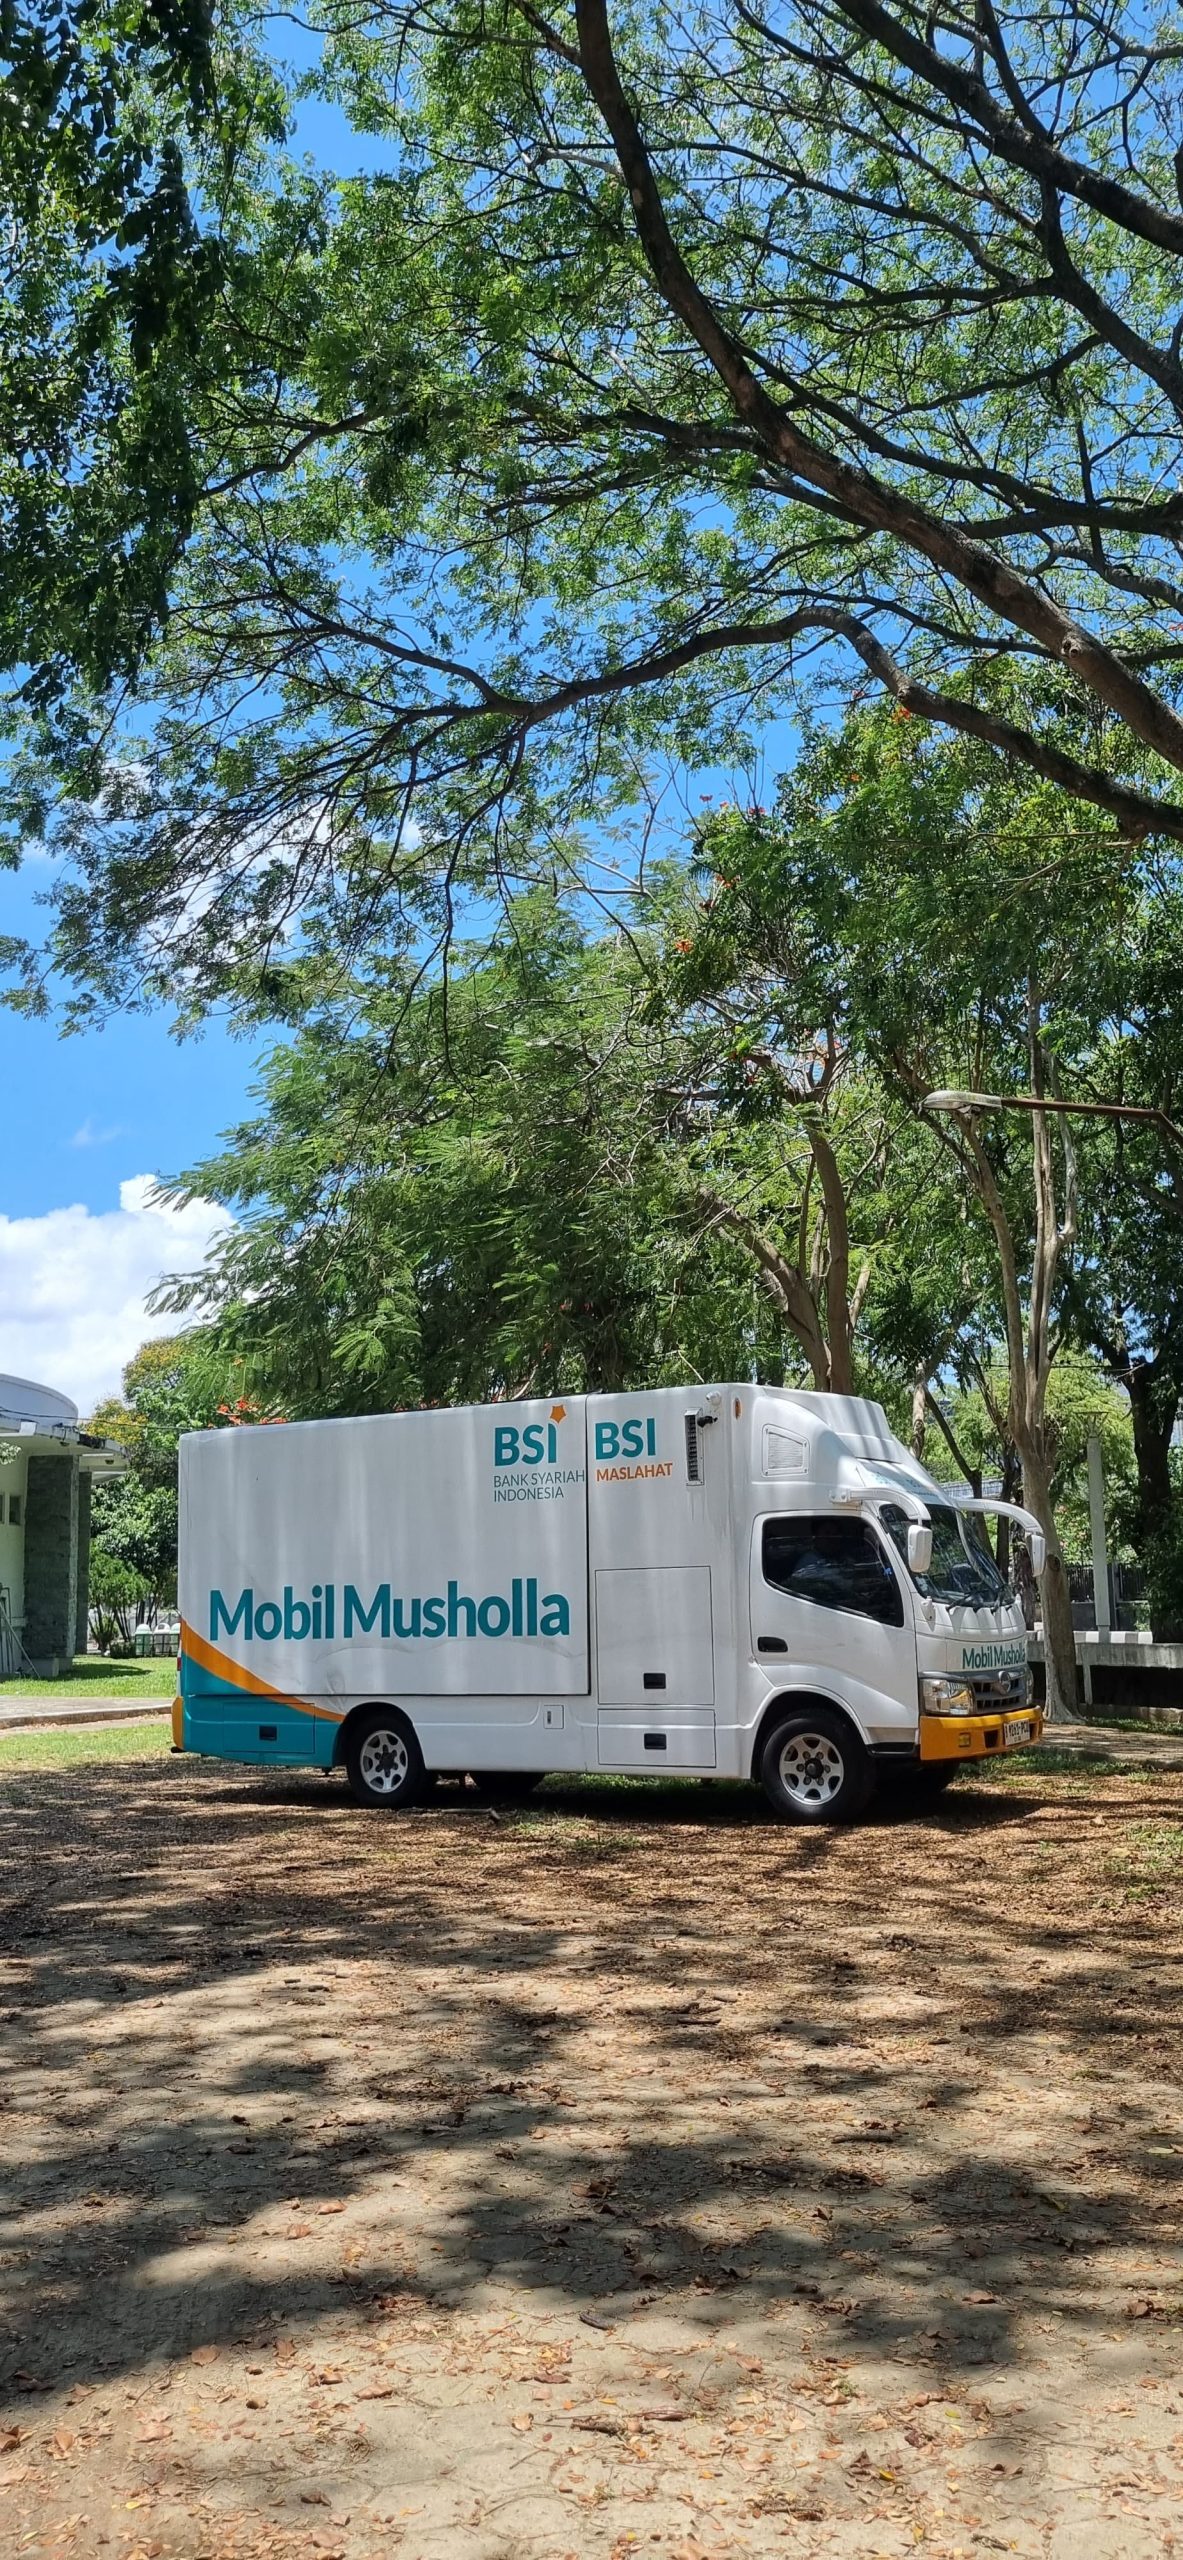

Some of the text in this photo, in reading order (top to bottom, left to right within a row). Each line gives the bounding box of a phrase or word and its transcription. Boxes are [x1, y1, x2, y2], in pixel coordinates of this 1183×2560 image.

[494, 1423, 557, 1466] BSI
[595, 1418, 656, 1460] BSI
[493, 1470, 585, 1488] BANK SYARIAH
[596, 1462, 673, 1482] MASLAHAT
[493, 1486, 564, 1502] INDONESIA
[209, 1577, 570, 1641] Mobil Musholla
[962, 1642, 1026, 1669] Mobil Musholla
